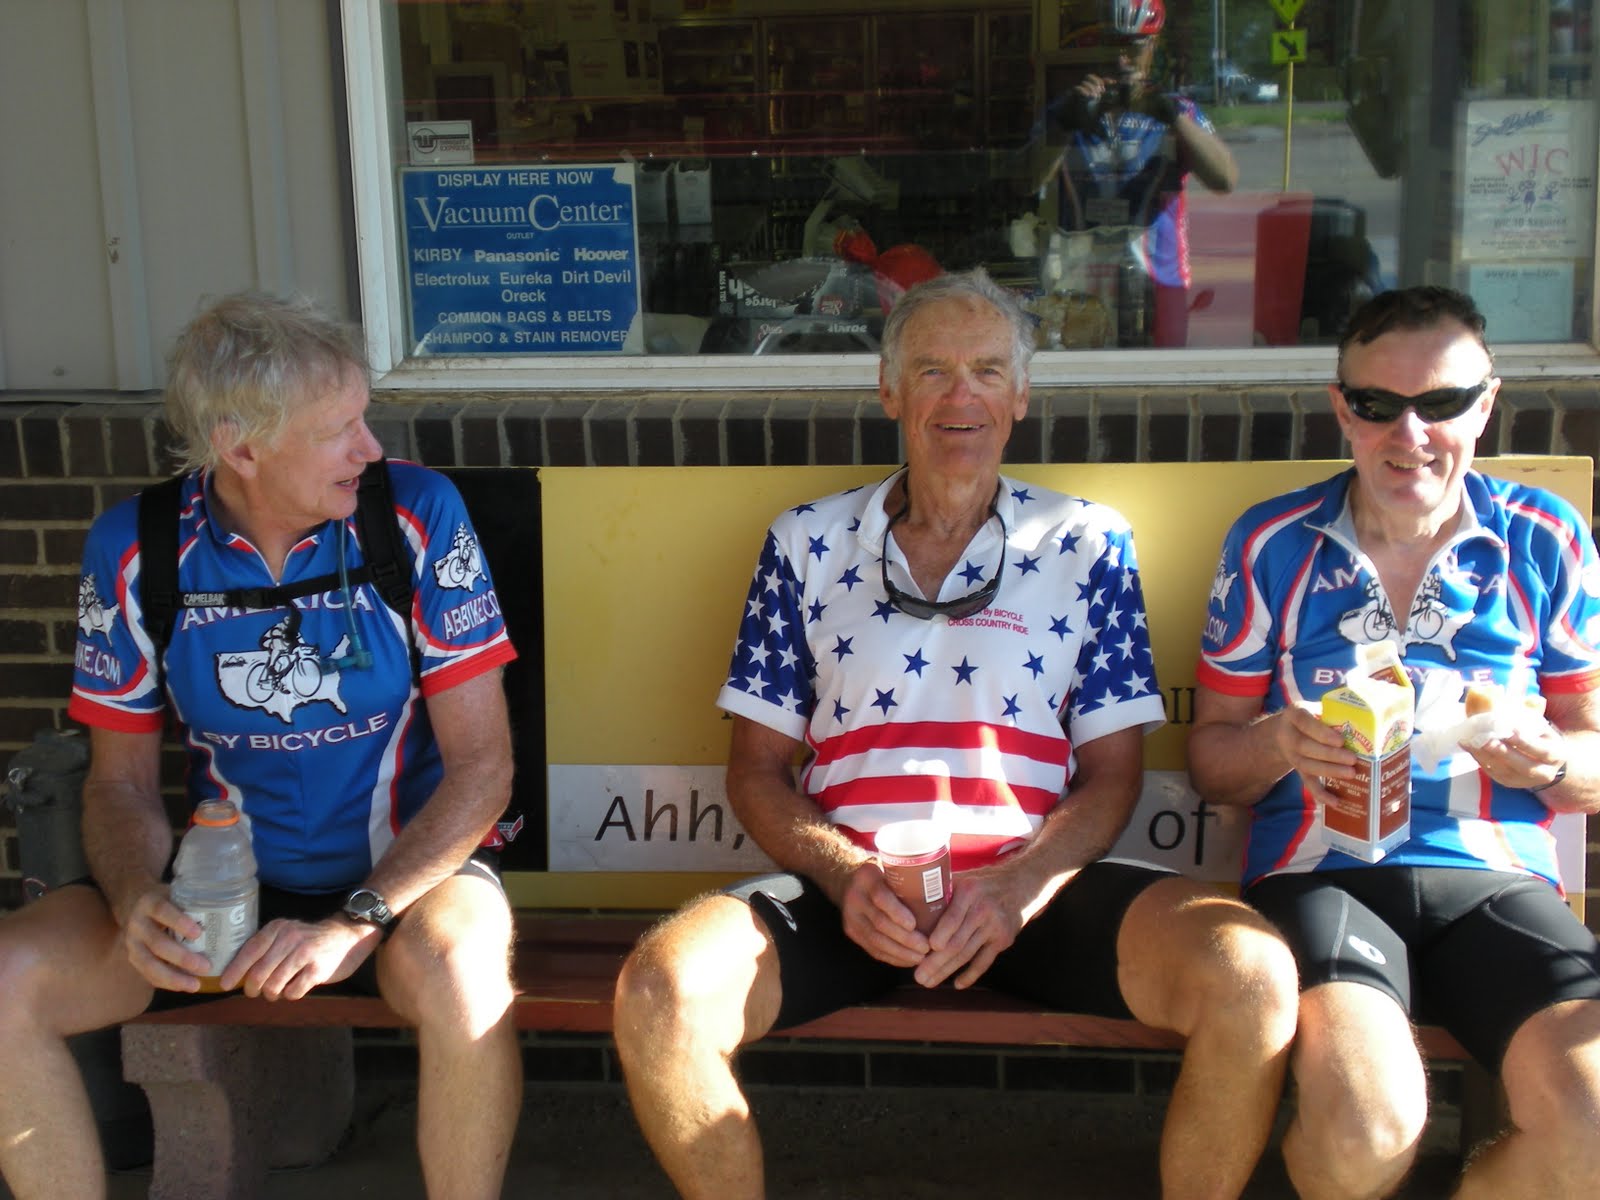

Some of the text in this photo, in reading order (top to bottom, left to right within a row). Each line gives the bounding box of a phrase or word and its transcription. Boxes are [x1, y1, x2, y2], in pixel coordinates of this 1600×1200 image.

[1495, 143, 1569, 176] WIC
[438, 171, 594, 187] DISPLAY HERE NOW
[506, 232, 534, 240] OUTLET
[414, 247, 629, 263] KIRBY Panasonic Hoover
[414, 269, 631, 286] Electrolux Eureka Dirt Devil
[501, 289, 546, 302] Oreck
[438, 309, 611, 324] COMMON BAGS & BELTS
[423, 331, 493, 345] SHAMPOO
[499, 331, 509, 344] &
[514, 330, 555, 344] STAIN
[994, 608, 1024, 622] BICYCLE
[947, 617, 1029, 635] CROSS COUNTRY RIDE
[249, 712, 390, 751] BICYCLE
[594, 789, 1217, 866] Ahh, of
